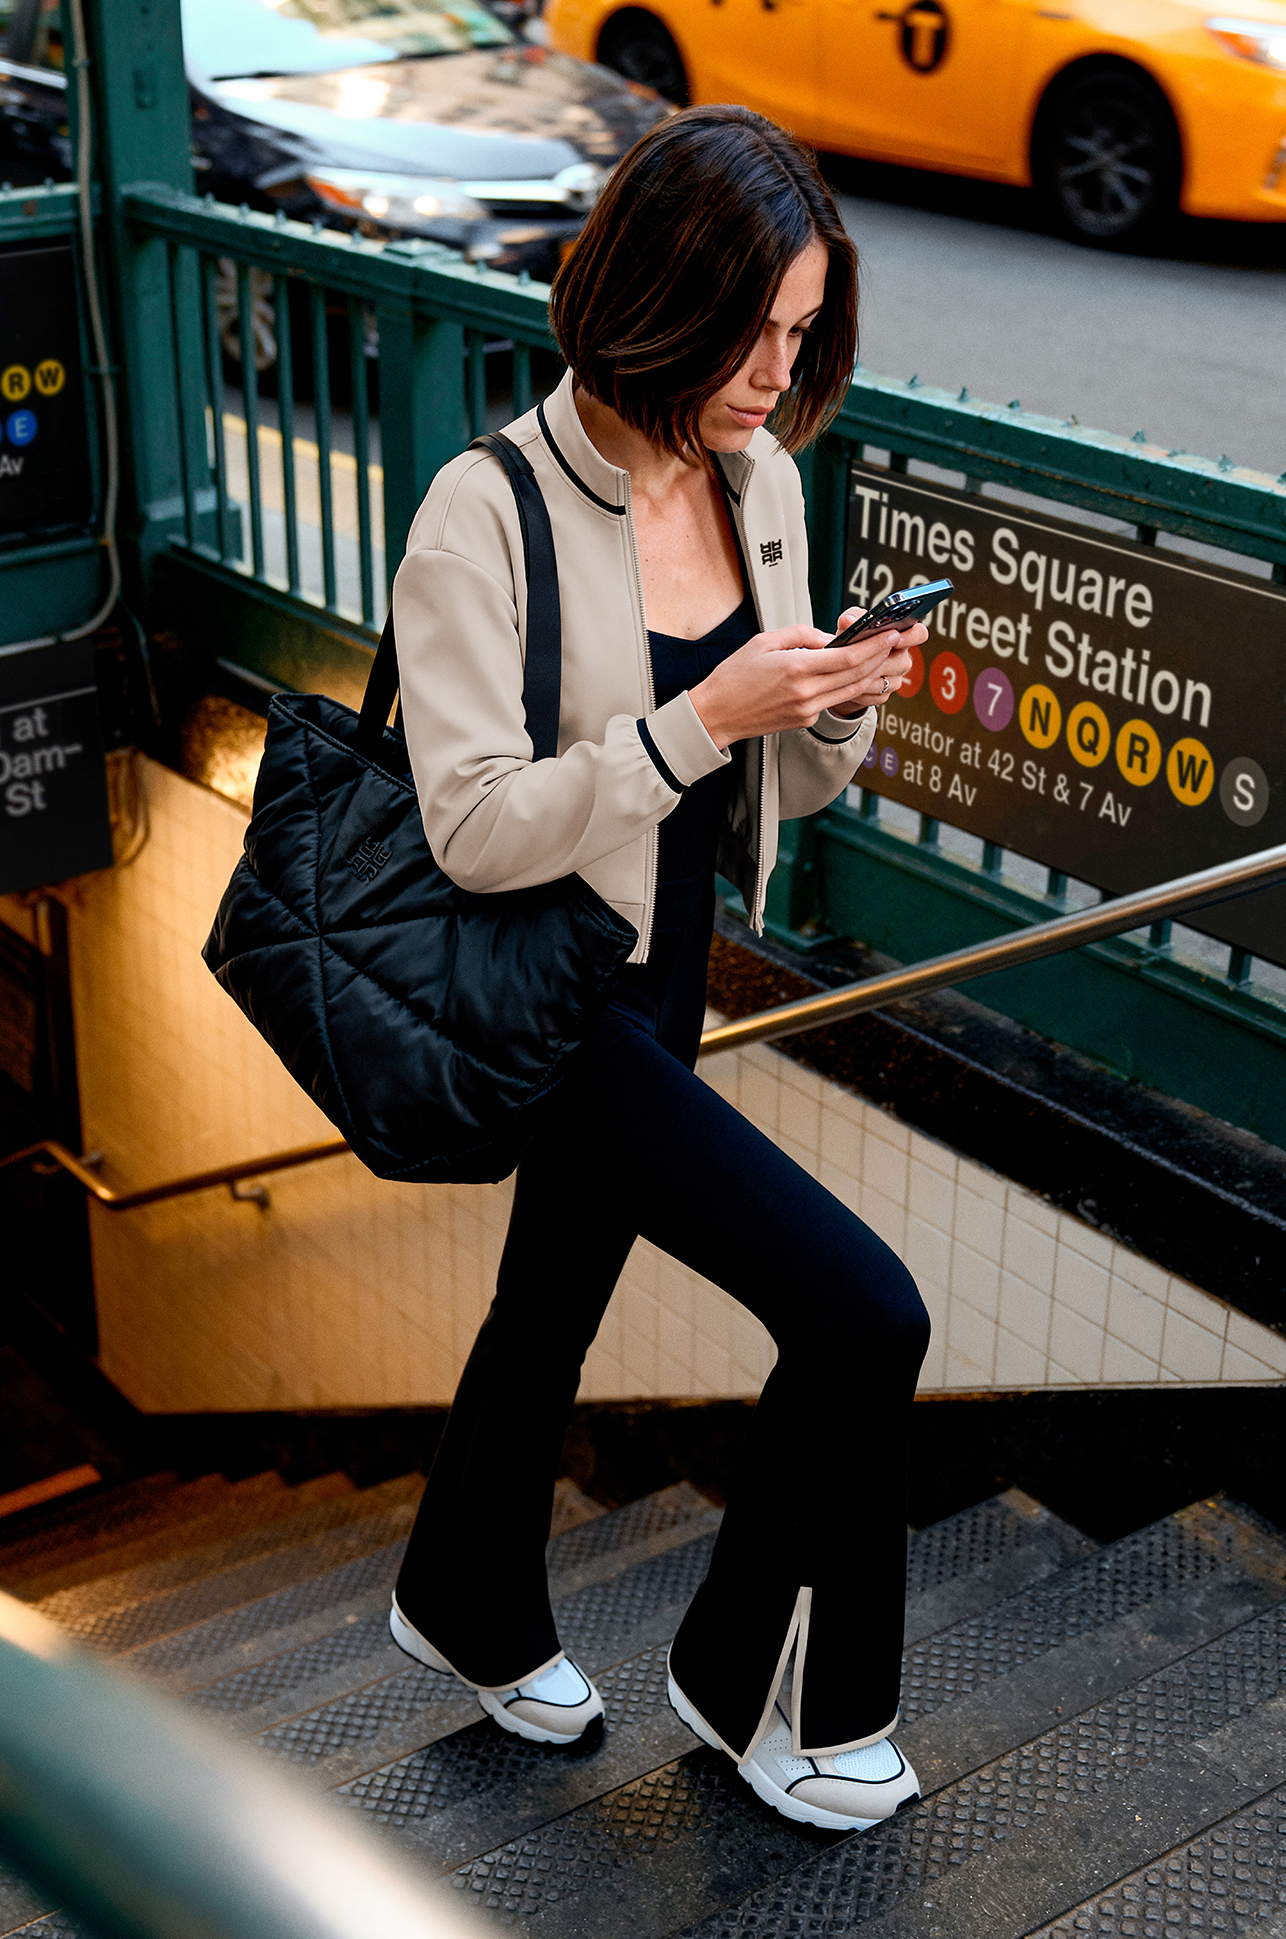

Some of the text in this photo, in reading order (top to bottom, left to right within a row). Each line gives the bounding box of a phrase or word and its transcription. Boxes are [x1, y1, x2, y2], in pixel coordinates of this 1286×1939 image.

[8, 365, 61, 395] R W
[14, 416, 28, 439] E
[0, 453, 24, 478] Av
[855, 484, 1154, 629] Times Square
[848, 557, 894, 608] 42
[1045, 620, 1212, 728] Station
[12, 706, 50, 743] at
[940, 666, 1256, 812] 3 7 N Q R W S
[877, 704, 955, 758] levator
[959, 741, 982, 770] at
[987, 748, 1015, 783] 42
[1021, 760, 1048, 796] St
[1053, 773, 1071, 806] &
[1079, 781, 1094, 812] 7
[1098, 791, 1133, 828] Av
[903, 759, 924, 787] at
[928, 764, 942, 794] 8
[947, 773, 978, 808] Av
[5, 779, 47, 817] St
